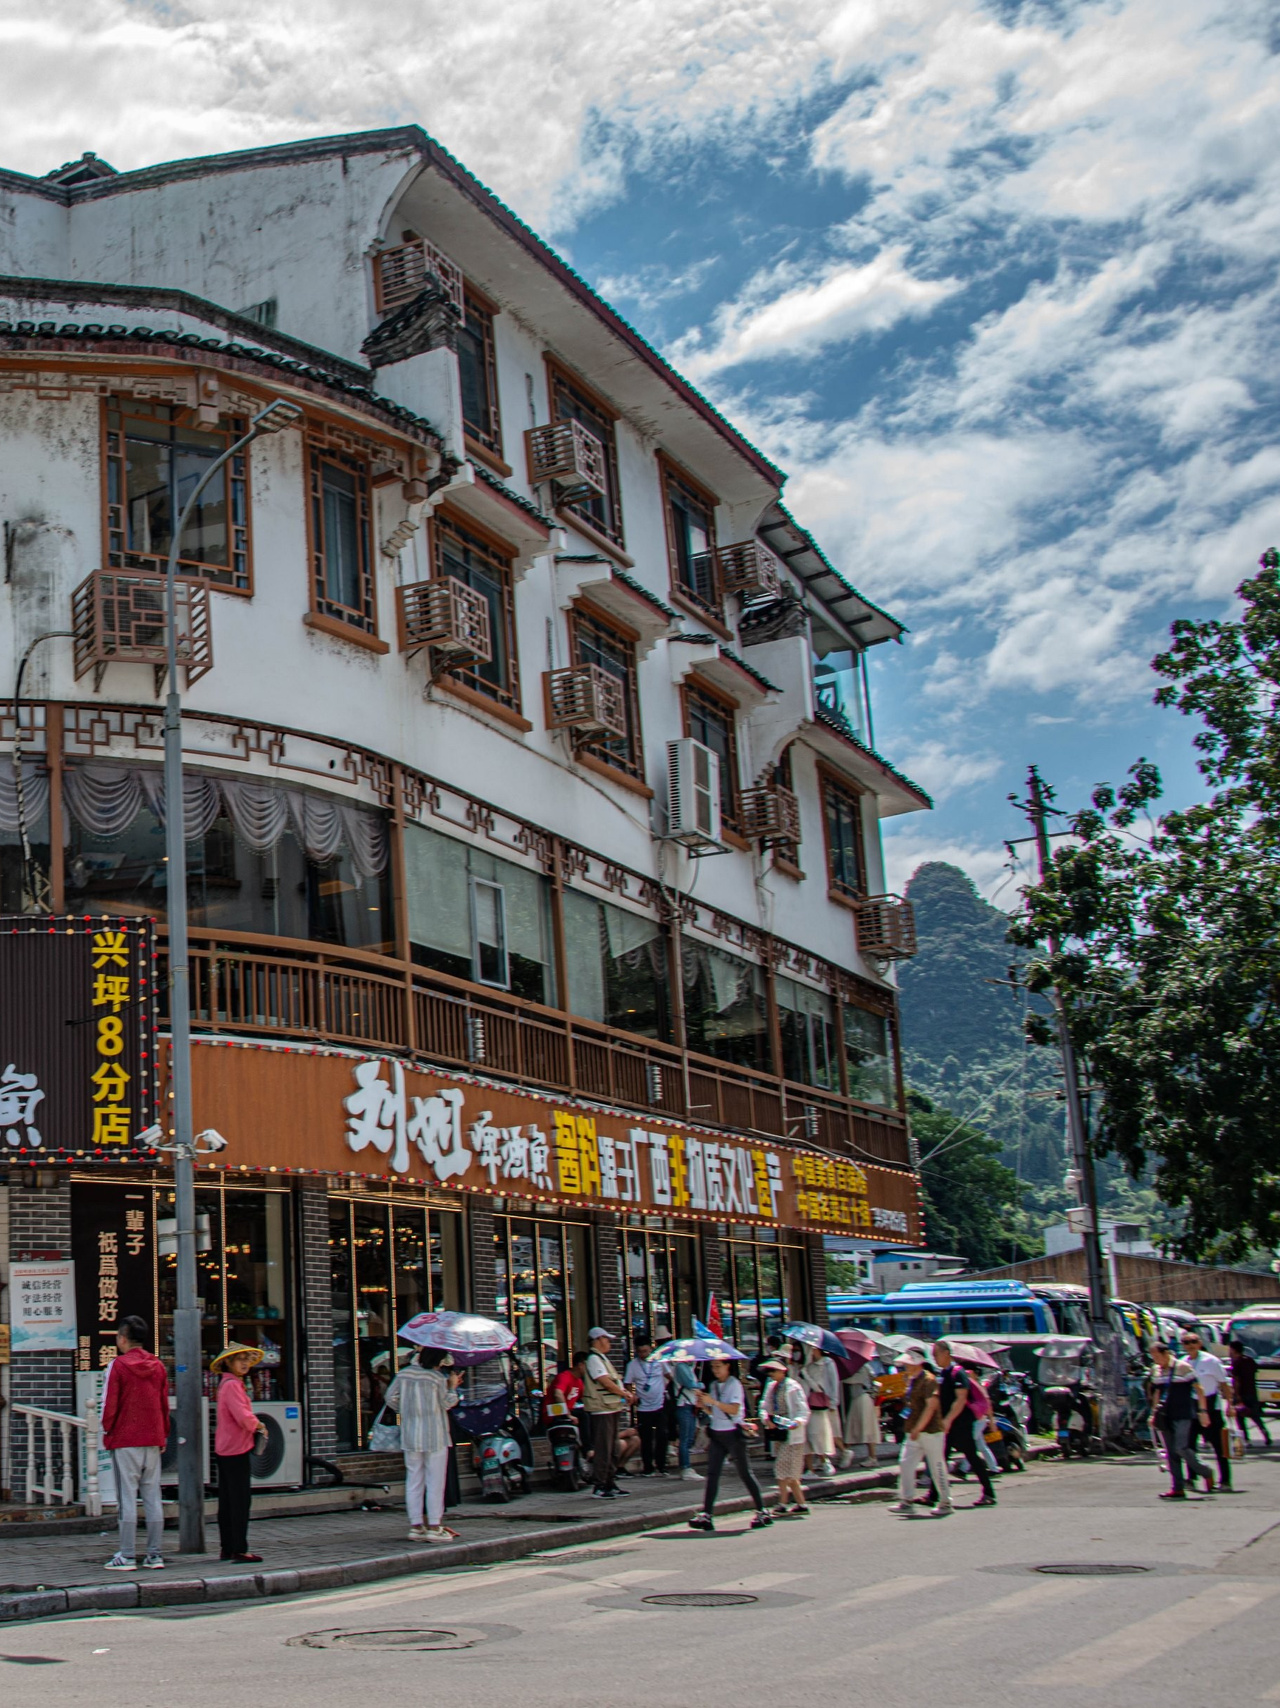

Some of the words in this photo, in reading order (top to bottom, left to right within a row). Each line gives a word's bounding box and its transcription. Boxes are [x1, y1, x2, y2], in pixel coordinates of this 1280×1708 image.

[91, 932, 131, 1146] 兴坪8分店
[553, 1110, 783, 1218] 酱料源于广西非物质文化遗产
